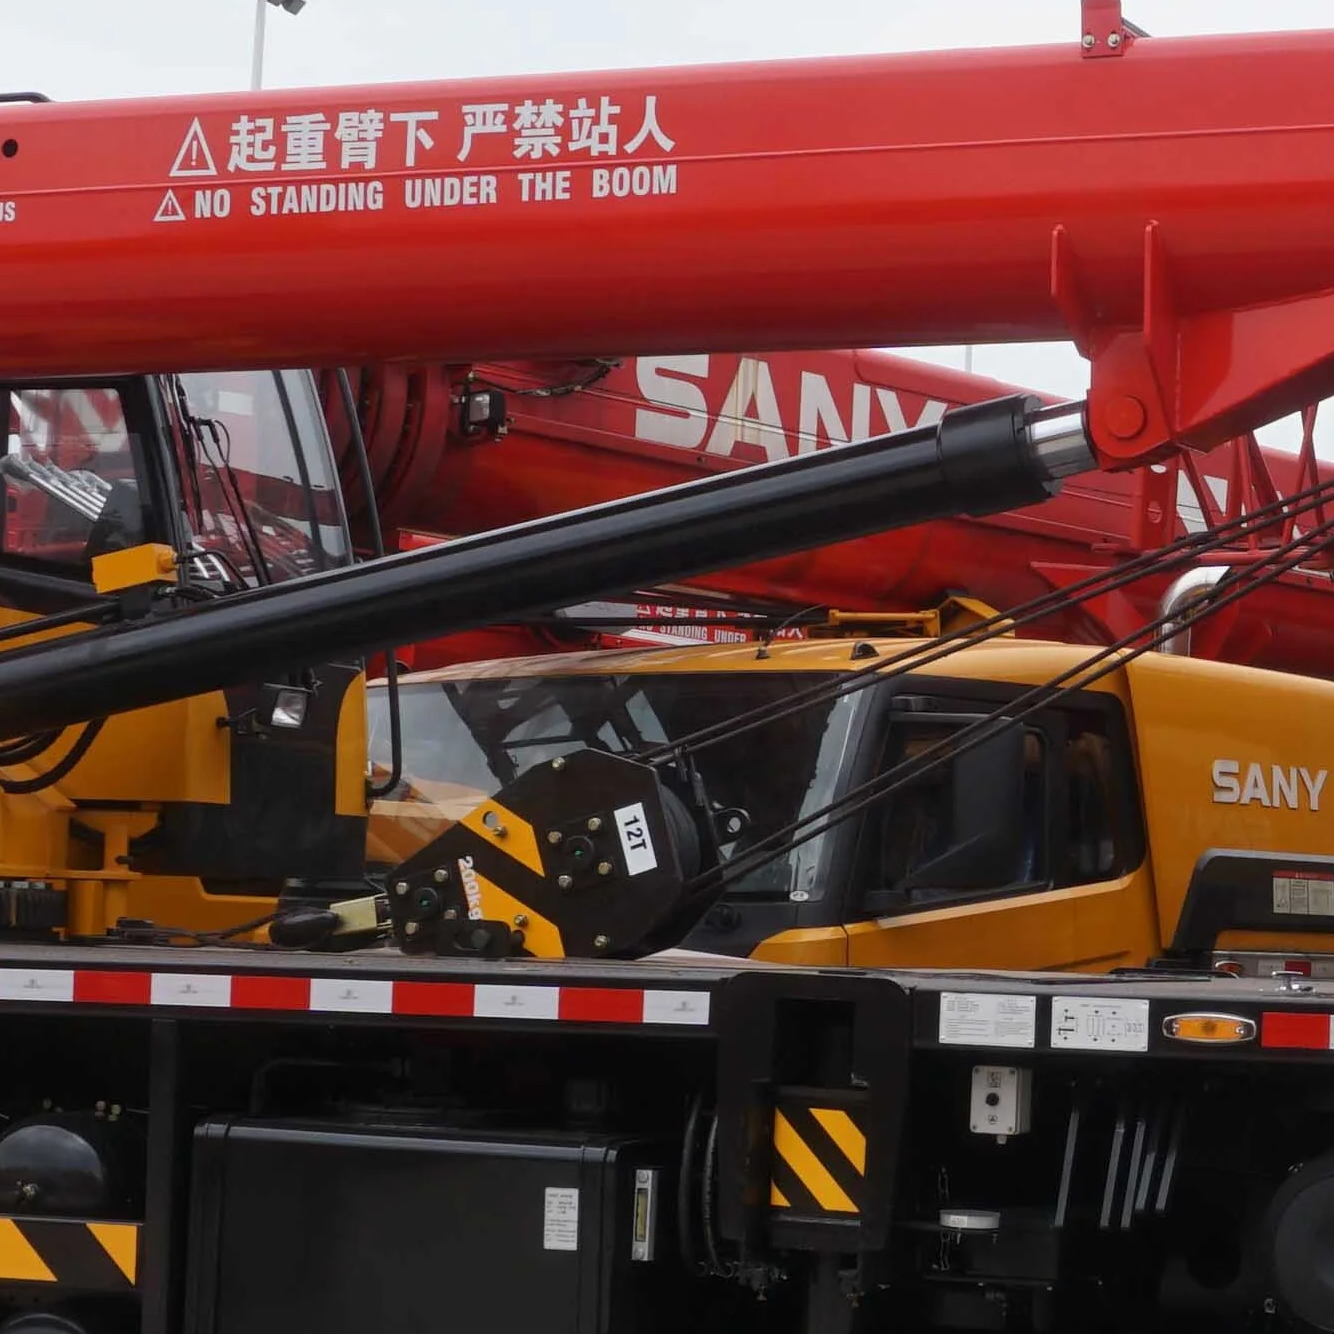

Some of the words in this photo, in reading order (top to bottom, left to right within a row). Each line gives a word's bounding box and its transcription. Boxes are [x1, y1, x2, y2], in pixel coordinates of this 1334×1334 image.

[227, 107, 441, 173] 起重臂下
[456, 94, 677, 162] 严禁站人
[193, 187, 232, 219] NO
[249, 180, 385, 216] STANDING
[404, 174, 498, 209] UNDER
[517, 169, 572, 202] THE
[591, 164, 678, 199] BOOM
[1212, 758, 1328, 810] SANY
[624, 815, 648, 850] 12T
